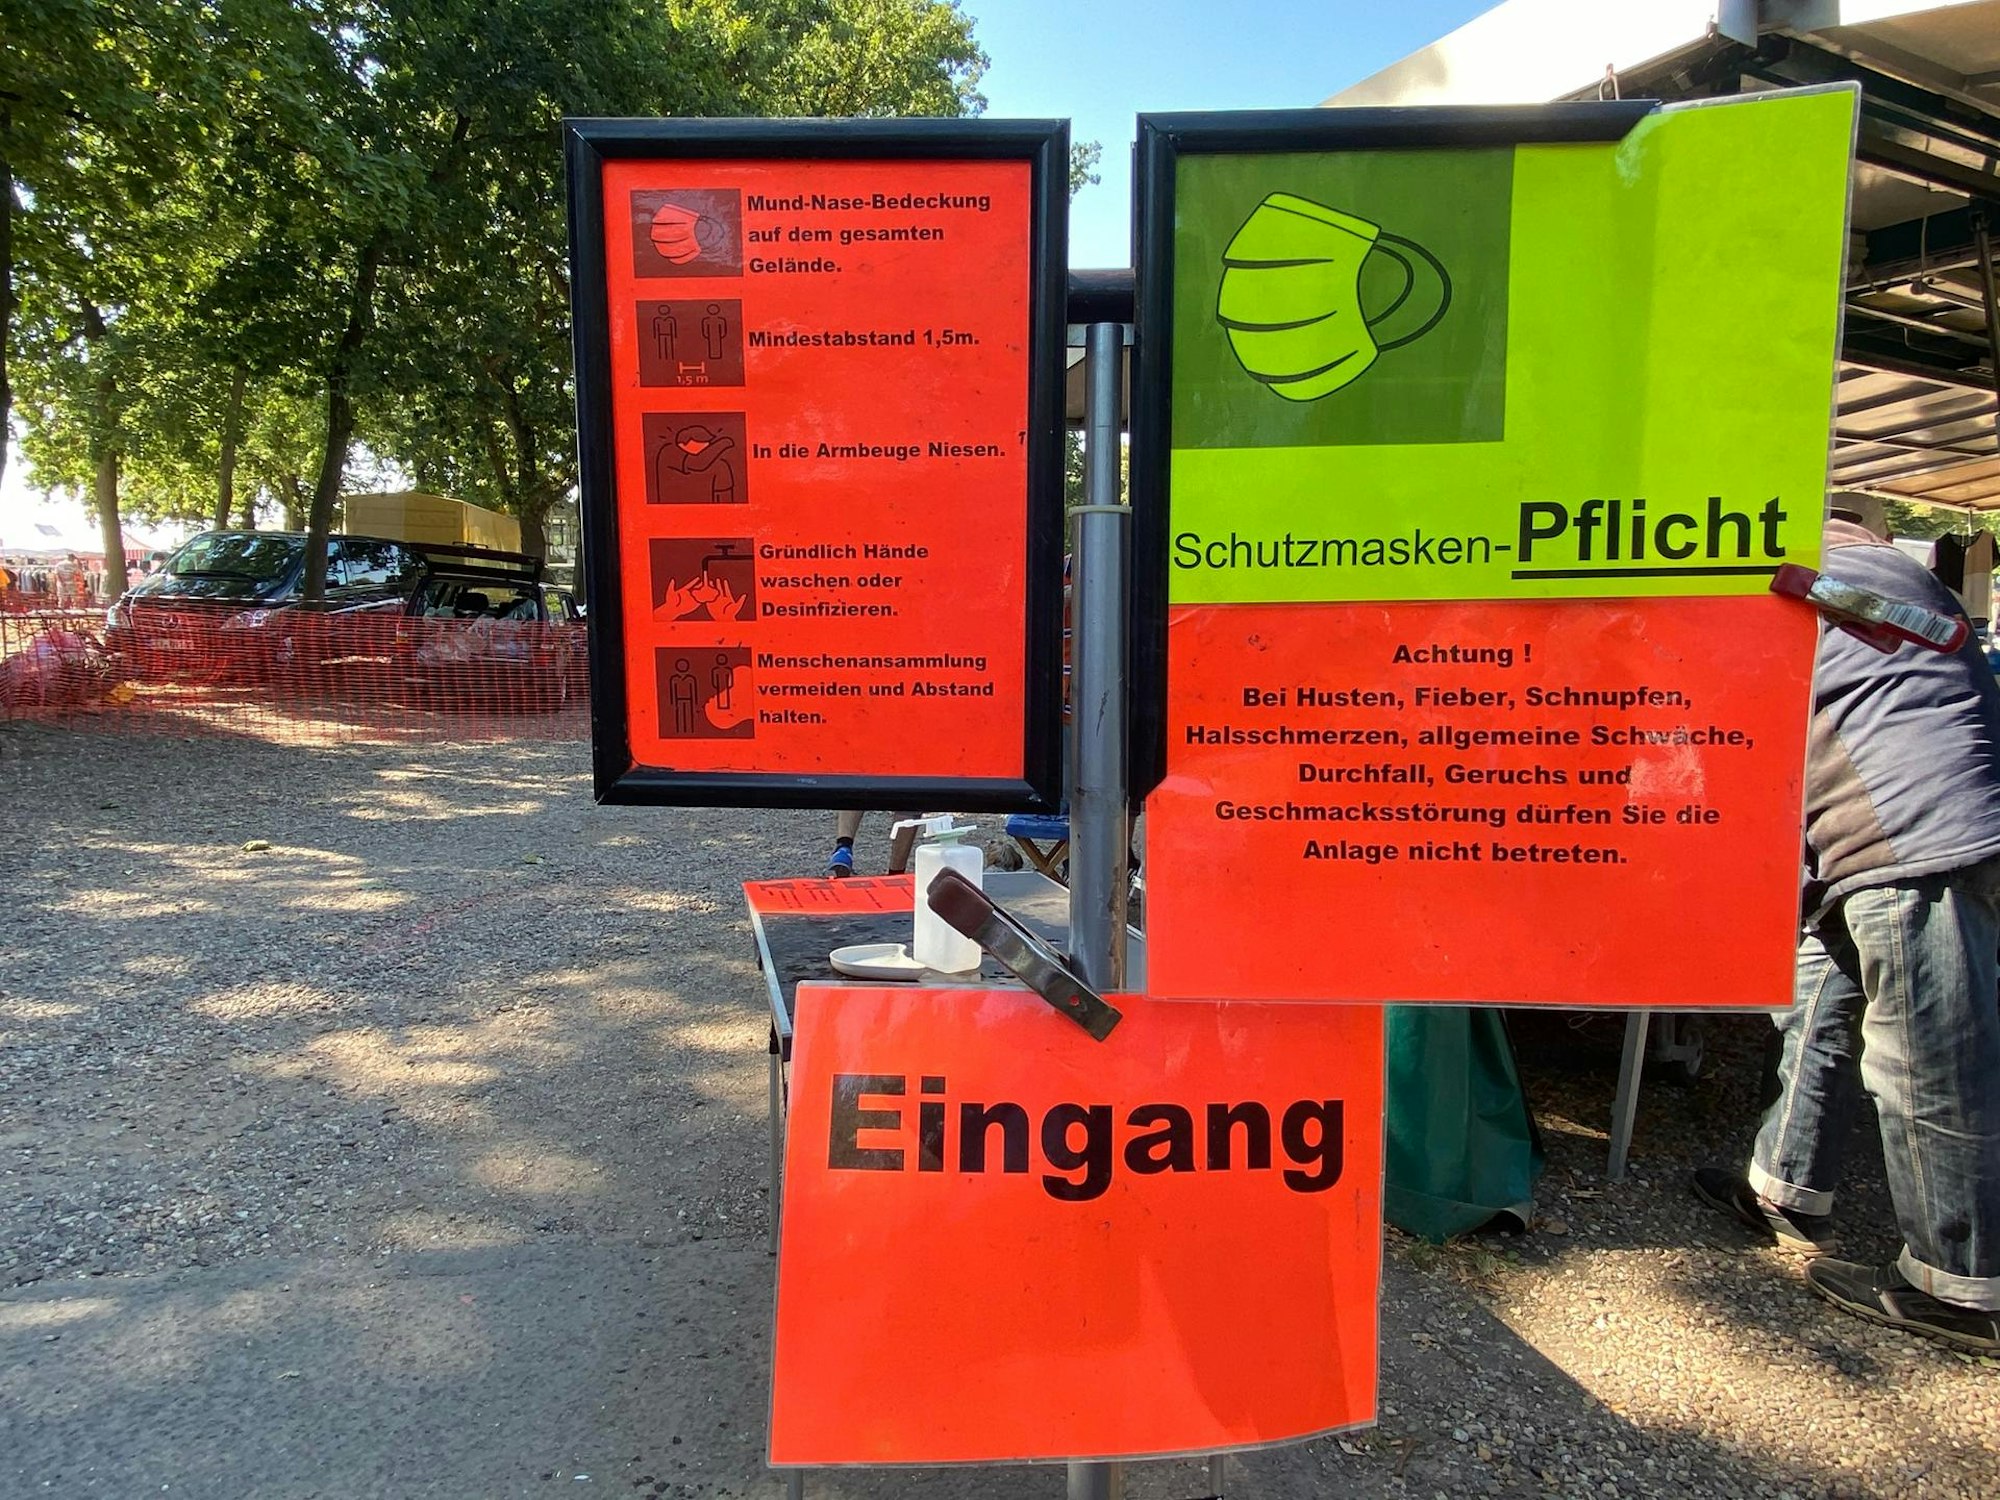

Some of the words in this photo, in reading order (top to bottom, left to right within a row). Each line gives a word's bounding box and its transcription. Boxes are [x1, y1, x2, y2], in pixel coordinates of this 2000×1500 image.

[747, 192, 991, 212] Mund-Nase-Bedeckung
[748, 226, 782, 243] auf
[788, 226, 833, 242] dem
[839, 225, 944, 246] gesamten
[748, 256, 842, 274] Gelände.
[748, 329, 915, 347] Mindestabstand
[923, 329, 980, 349] 1,5m.
[675, 374, 693, 386] 1,5
[695, 375, 709, 384] m
[753, 443, 772, 459] In
[778, 443, 810, 459] die
[816, 442, 921, 462] Armbeuge
[928, 441, 1005, 457] Niesen.
[759, 544, 857, 560] Gründlich
[863, 543, 929, 559] Hände
[760, 573, 850, 588] waschen
[856, 572, 902, 588] oder
[761, 601, 898, 617] Desinfizieren.
[757, 653, 987, 672] Menschenansammlung
[1392, 644, 1514, 668] Achtung
[758, 681, 862, 696] vermeiden
[868, 681, 905, 697] und
[911, 681, 994, 697] Abstand
[1243, 687, 1286, 707] Bei
[1296, 687, 1404, 711] Husten,
[1415, 686, 1515, 711] Fieber,
[1525, 686, 1691, 711] Schnupfen,
[759, 709, 827, 724] halten.
[1186, 725, 1408, 750] Halsschmerzen,
[1417, 725, 1581, 751] allgemeine
[1591, 725, 1754, 750] Schwäche,
[1299, 763, 1434, 788] Durchfall,
[1444, 763, 1568, 785] Geruchs
[1578, 765, 1632, 785] und
[1215, 800, 1506, 829] Geschmacksstörung
[1516, 803, 1612, 825] dürfen
[1622, 804, 1666, 825] Sie
[1675, 804, 1721, 825] die
[1303, 840, 1399, 865] Anlage
[1408, 841, 1482, 862] nicht
[1491, 842, 1627, 864] betreten.
[827, 1073, 1345, 1202] Eingang
